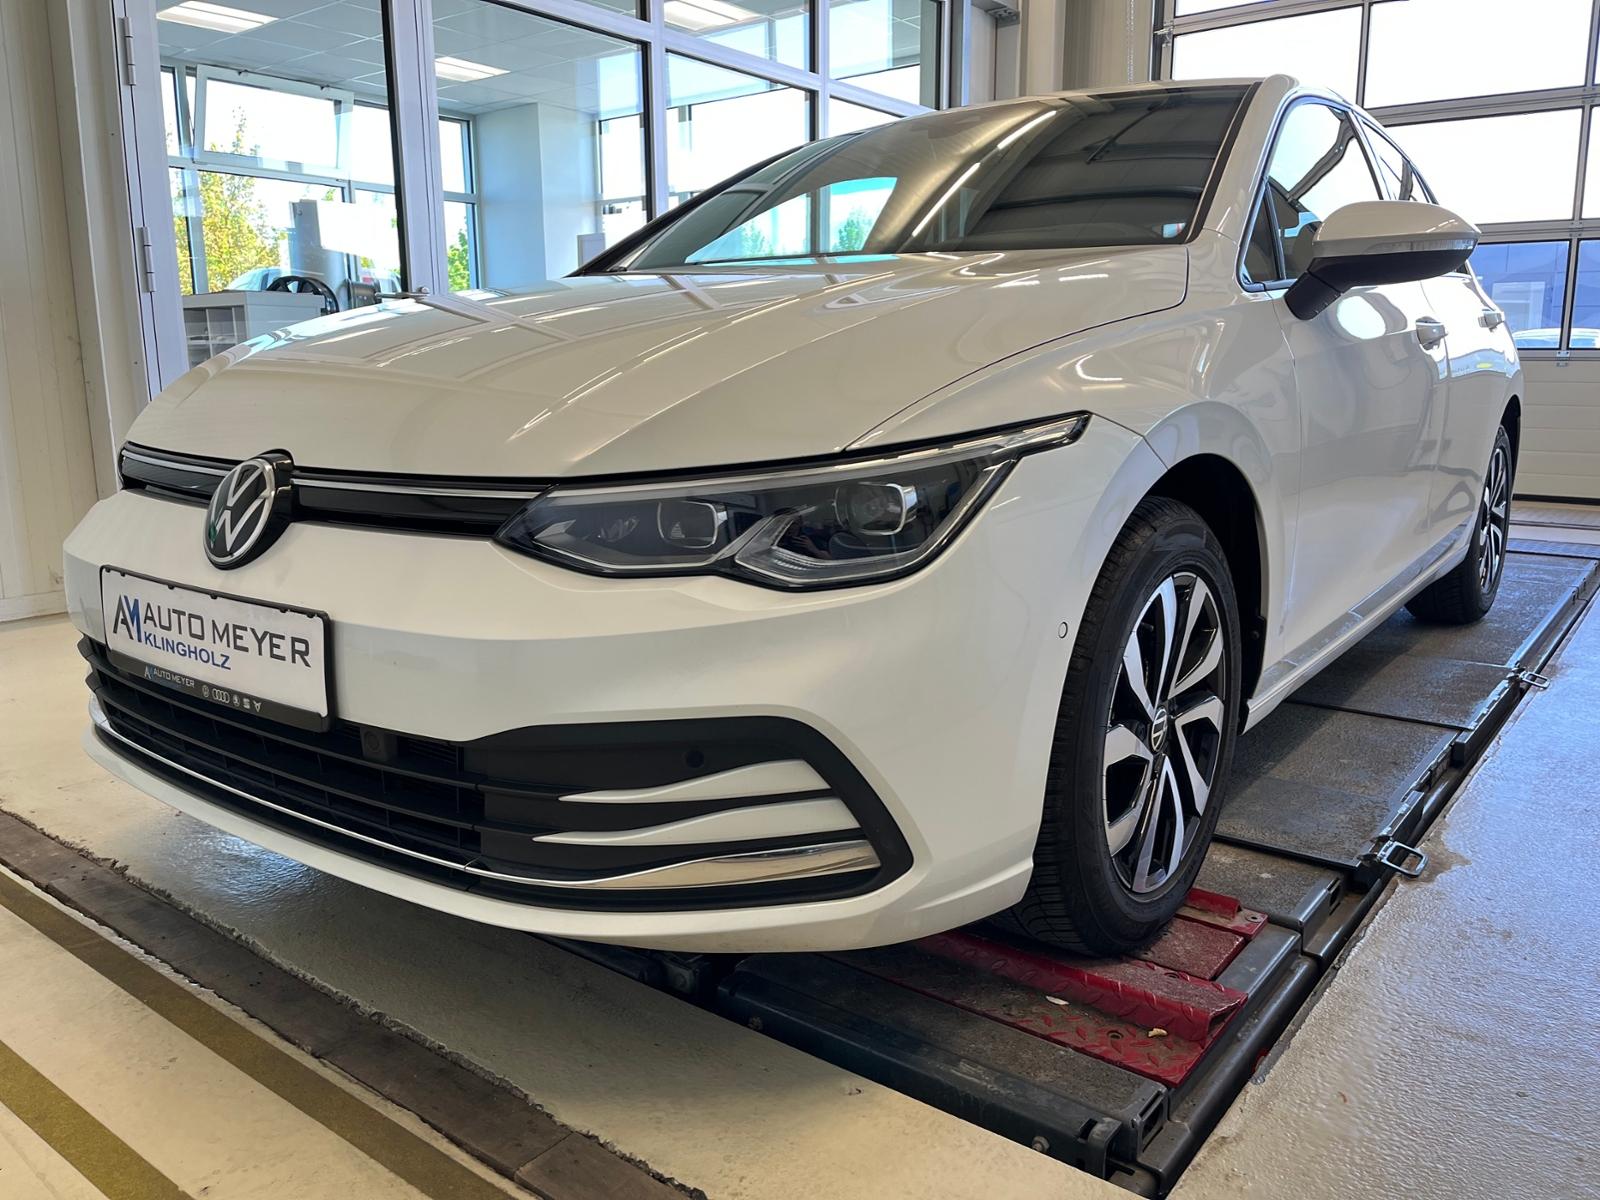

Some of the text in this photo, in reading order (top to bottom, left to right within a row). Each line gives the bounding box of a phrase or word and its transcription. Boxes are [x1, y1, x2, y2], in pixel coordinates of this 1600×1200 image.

[143, 602, 312, 668] AUTO MEYER
[144, 631, 232, 671] KLINGHOLZ
[153, 667, 171, 681] AUTO
[171, 673, 195, 688] MEYER
